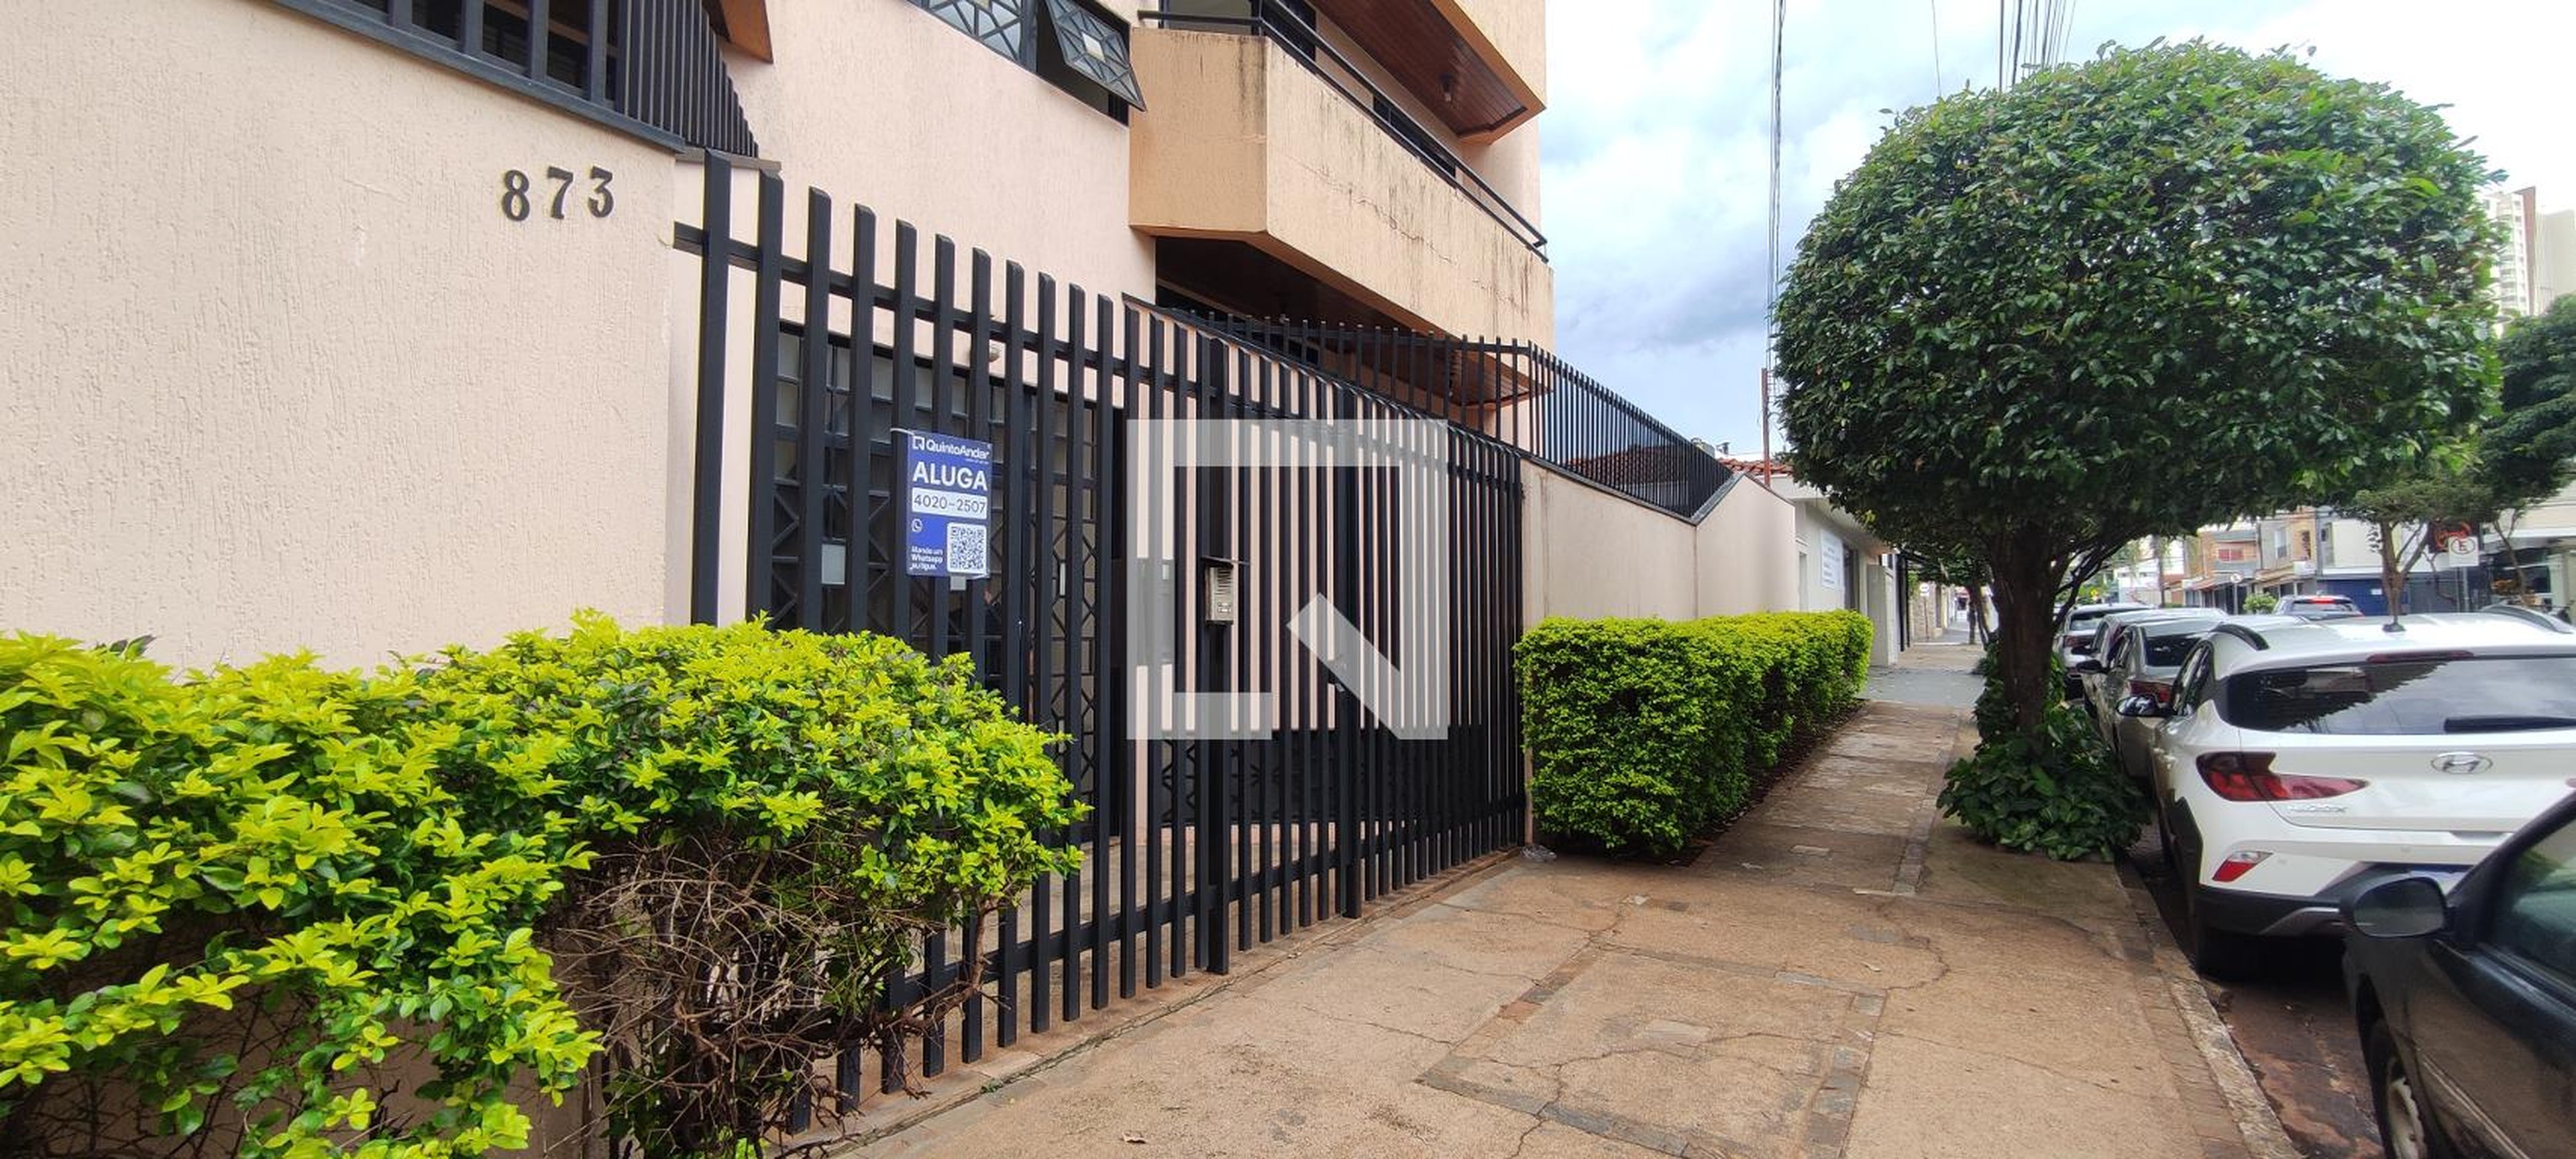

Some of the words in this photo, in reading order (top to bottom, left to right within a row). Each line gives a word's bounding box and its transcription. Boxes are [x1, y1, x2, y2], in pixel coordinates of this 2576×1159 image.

[501, 165, 614, 221] 873
[926, 439, 990, 460] QuintoAndar
[912, 461, 988, 492] ALUGA
[914, 494, 986, 514] 4020-2507
